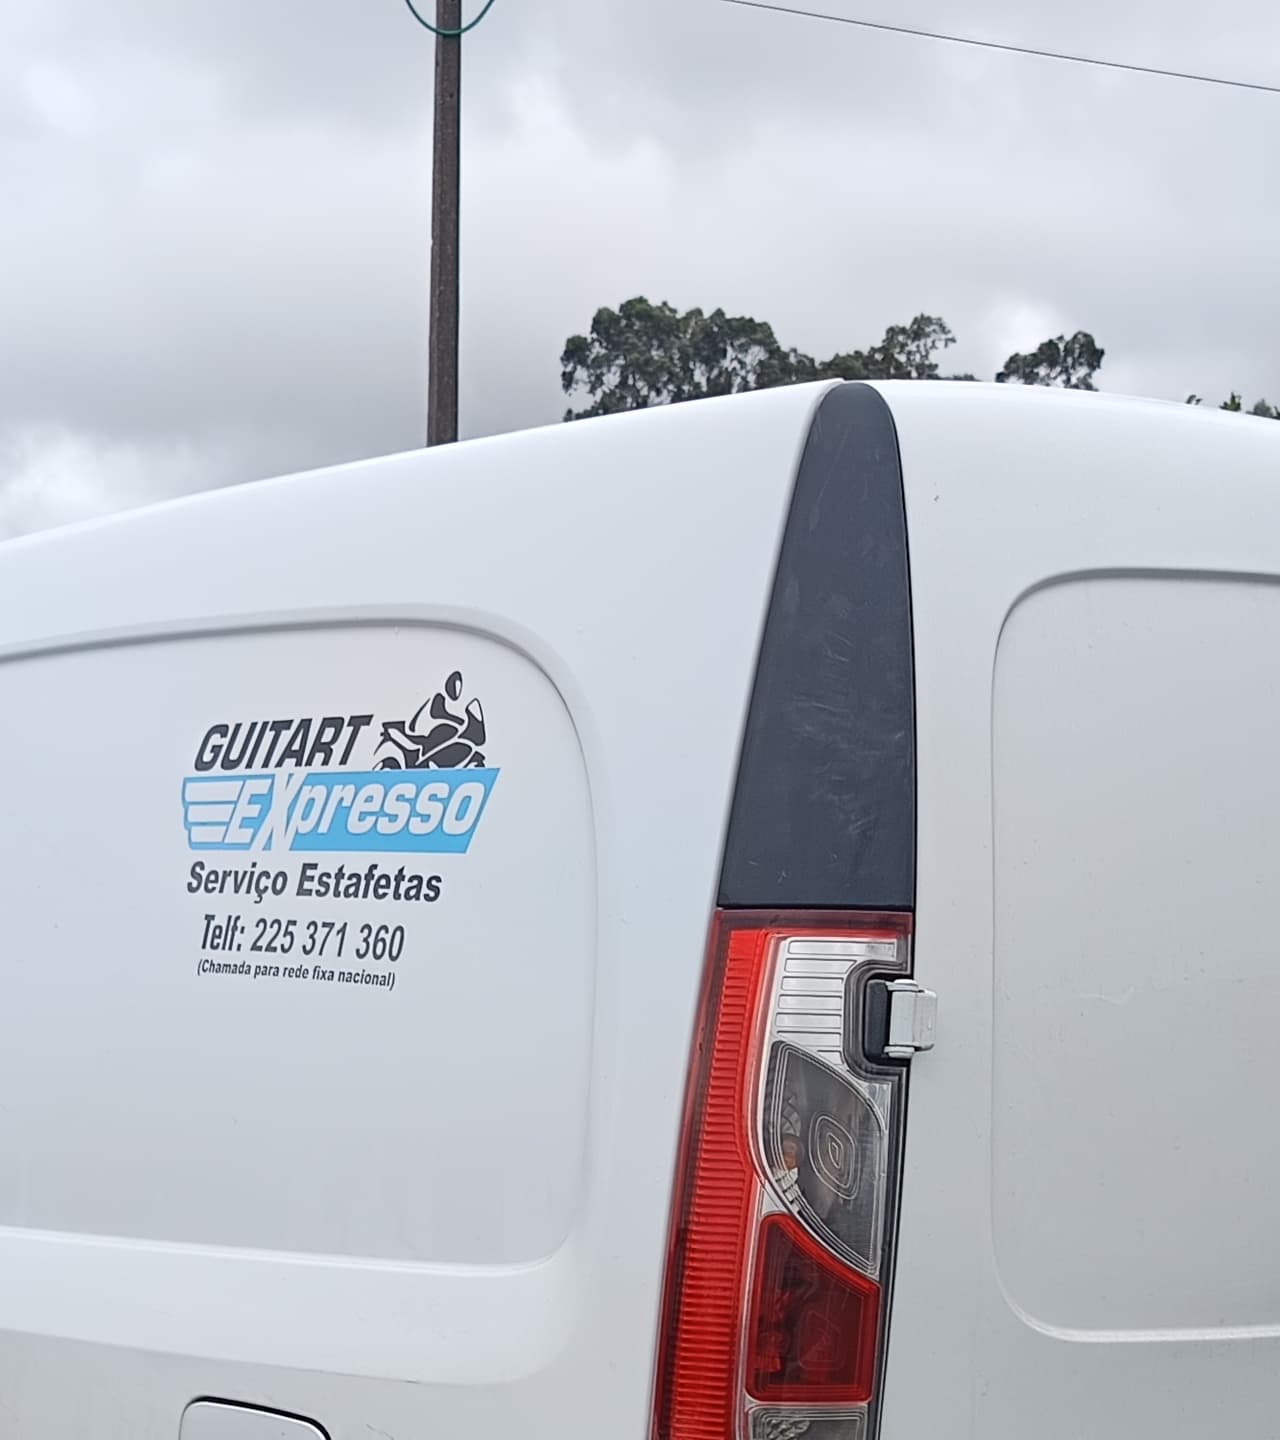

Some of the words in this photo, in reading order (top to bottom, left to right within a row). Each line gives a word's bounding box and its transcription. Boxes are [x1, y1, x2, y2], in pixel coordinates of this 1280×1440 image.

[193, 714, 374, 771] GUITART
[187, 860, 289, 904] Serviço
[296, 863, 443, 902] Estafetas
[201, 914, 245, 952] Telf:
[250, 917, 297, 954] 225
[302, 920, 348, 957] 371
[356, 923, 405, 962] 360
[197, 958, 251, 976] (Chamada
[253, 964, 280, 979] para
[283, 966, 309, 980] rede
[312, 966, 334, 982] fixa
[337, 969, 396, 991] nacional)
